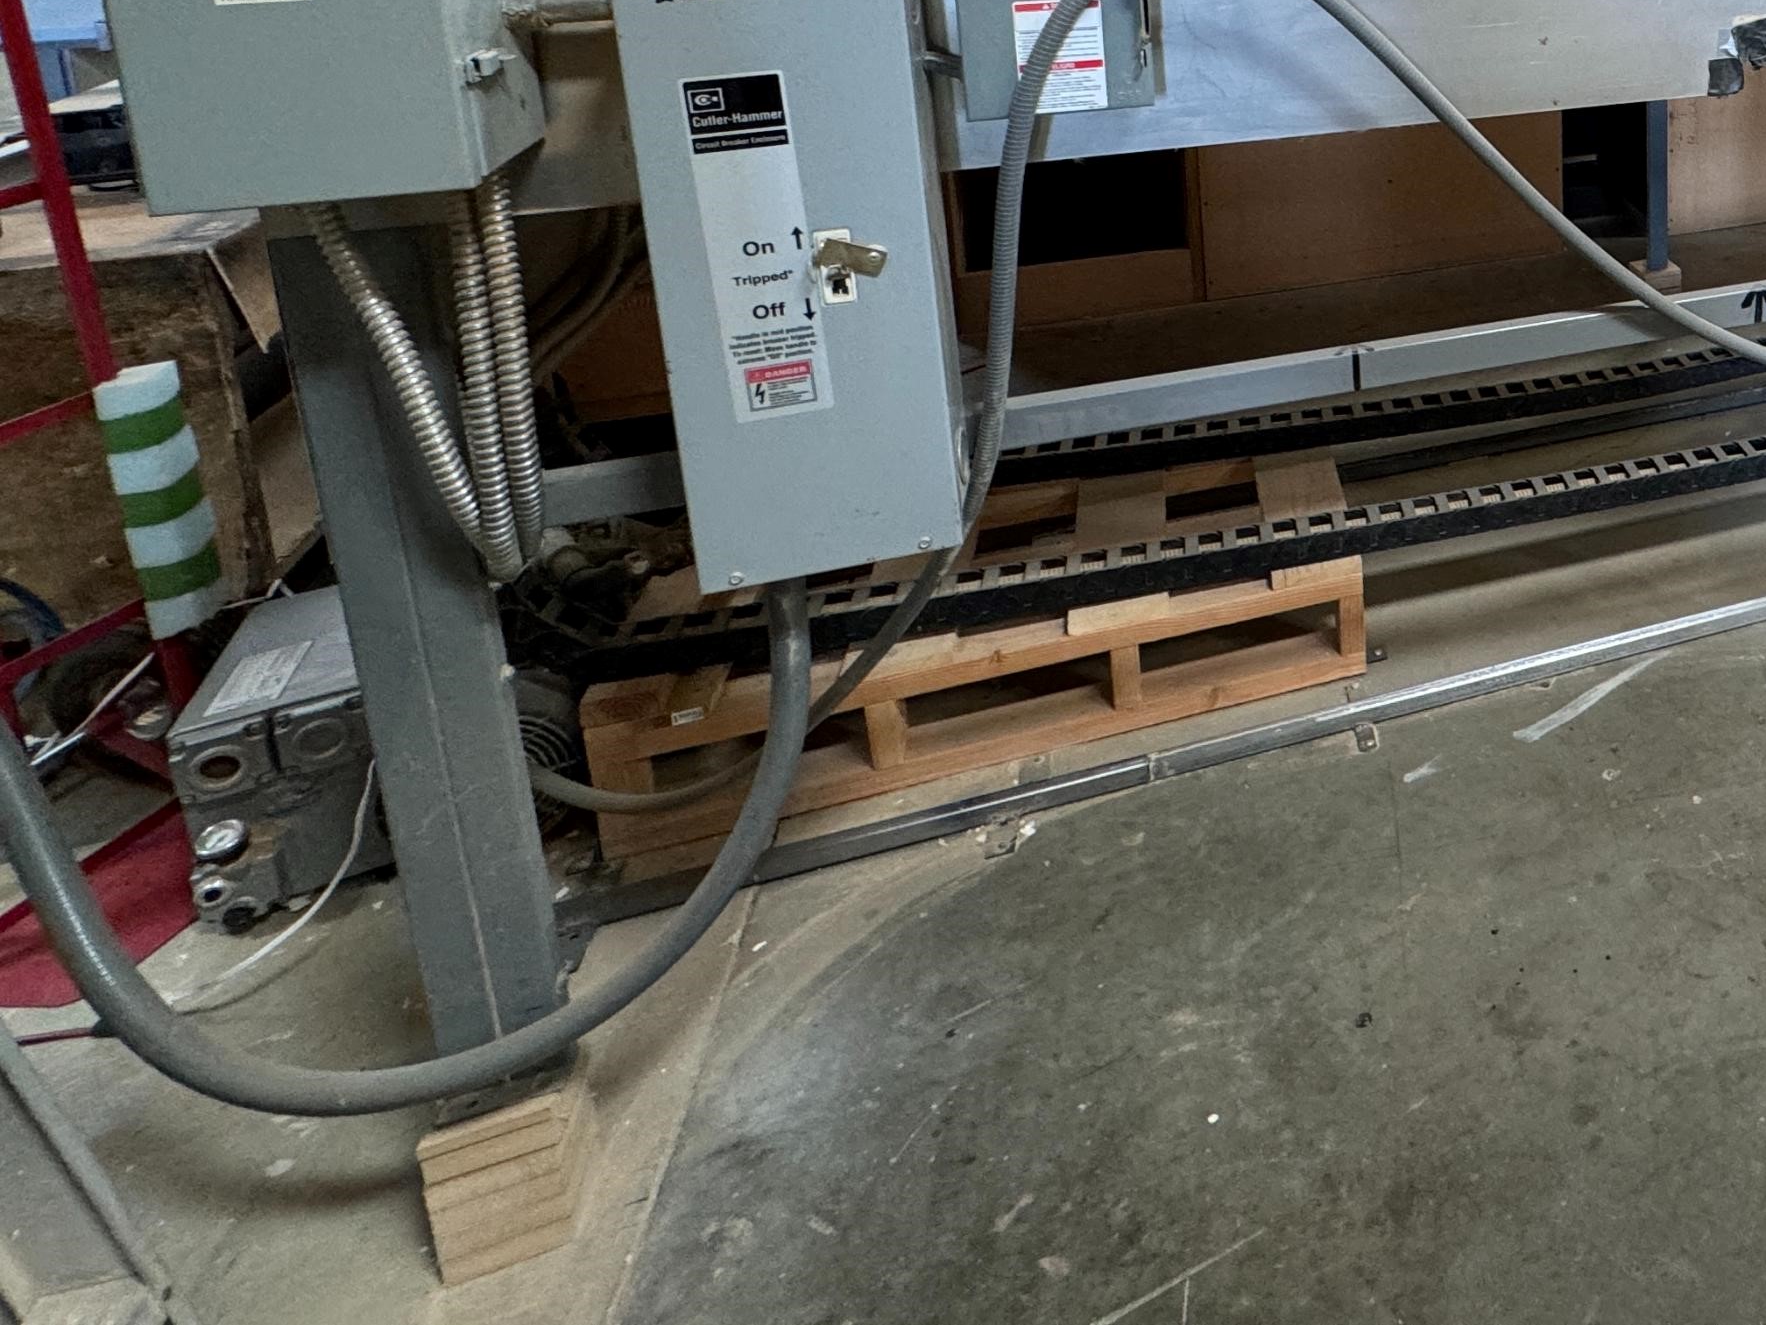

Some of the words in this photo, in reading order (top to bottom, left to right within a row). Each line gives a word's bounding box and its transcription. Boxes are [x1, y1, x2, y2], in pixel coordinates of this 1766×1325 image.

[692, 110, 783, 128] Cutler-Hammer
[742, 241, 775, 257] On
[752, 301, 785, 320] Off
